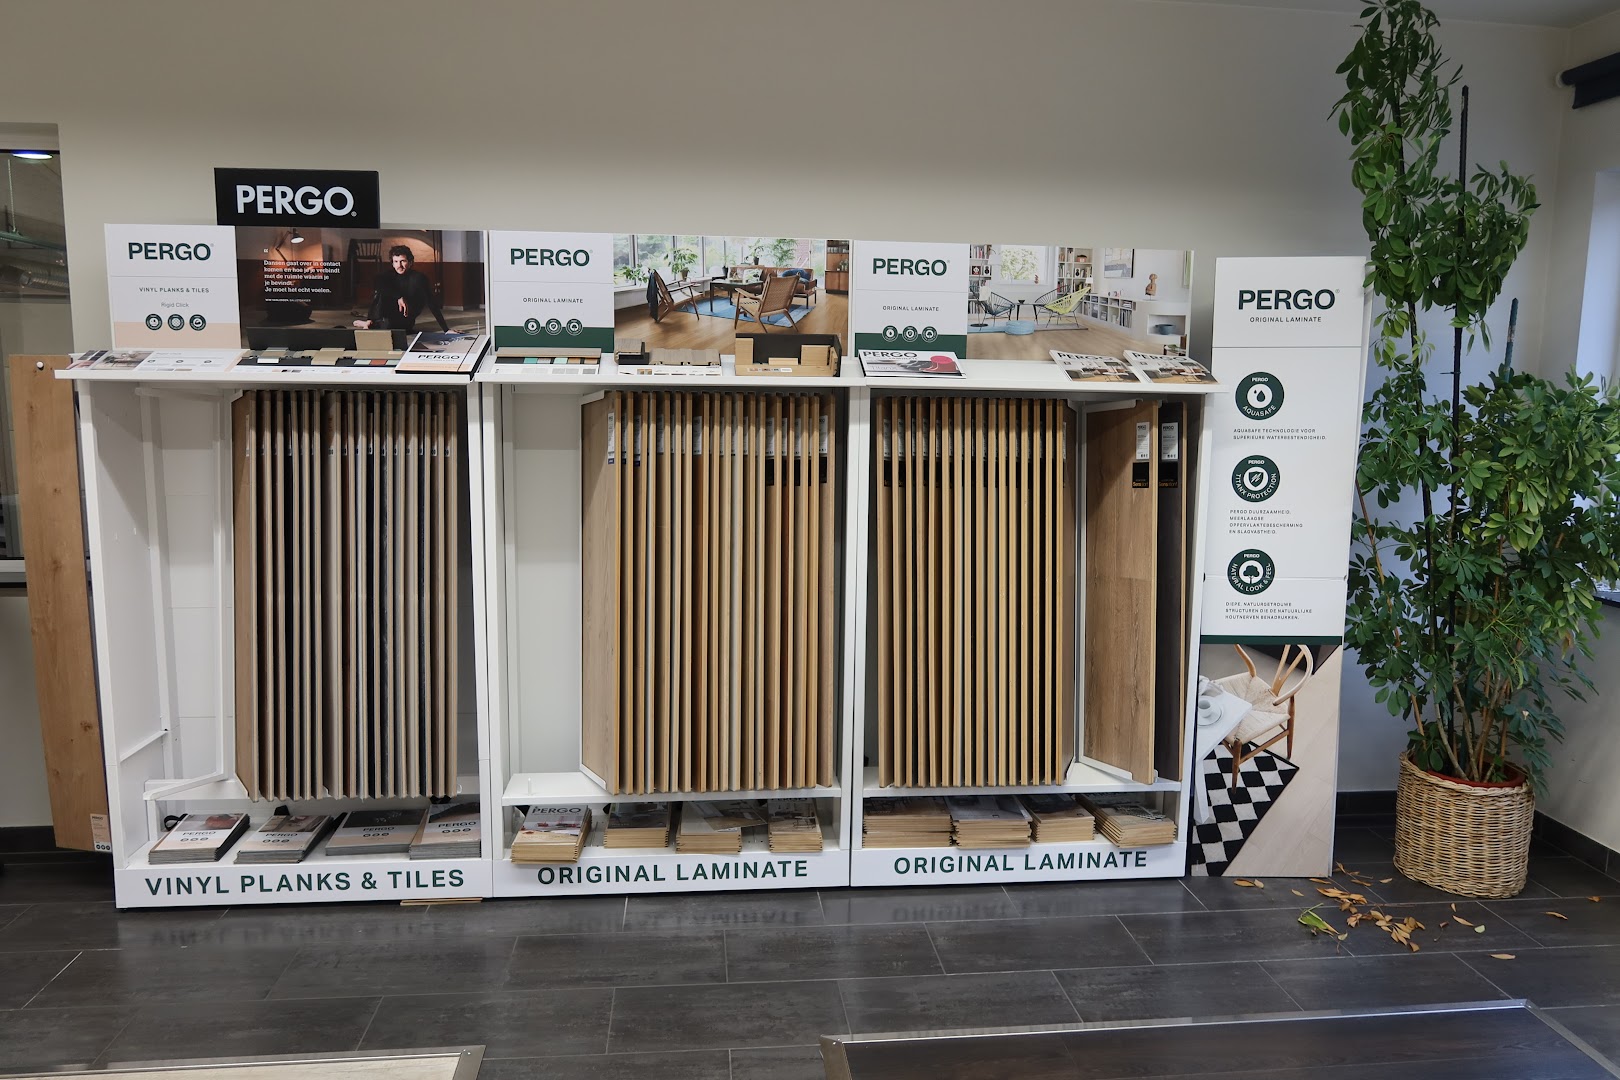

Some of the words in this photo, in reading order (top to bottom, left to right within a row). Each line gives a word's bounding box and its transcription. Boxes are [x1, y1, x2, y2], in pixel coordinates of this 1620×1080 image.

[236, 185, 354, 216] PERGO
[128, 242, 211, 260] PERGO
[510, 248, 590, 266] PERGO
[872, 258, 947, 276] PERGO
[1238, 289, 1336, 310] PERGO
[1243, 405, 1276, 416] AQUASAFE
[1236, 474, 1247, 495] TITANX
[1247, 473, 1276, 499] PROTECTION
[1231, 563, 1244, 590] NATURAL
[1246, 583, 1264, 592] LOOK
[537, 864, 666, 885] ORIGINAL
[676, 860, 808, 881] LAMINATE
[894, 854, 1014, 875] ORIGINAL
[1024, 851, 1147, 871] LAMINATE
[145, 876, 229, 896] VINYL
[240, 872, 350, 893] PLANKS
[361, 872, 378, 890] &
[387, 869, 464, 889] TILES
